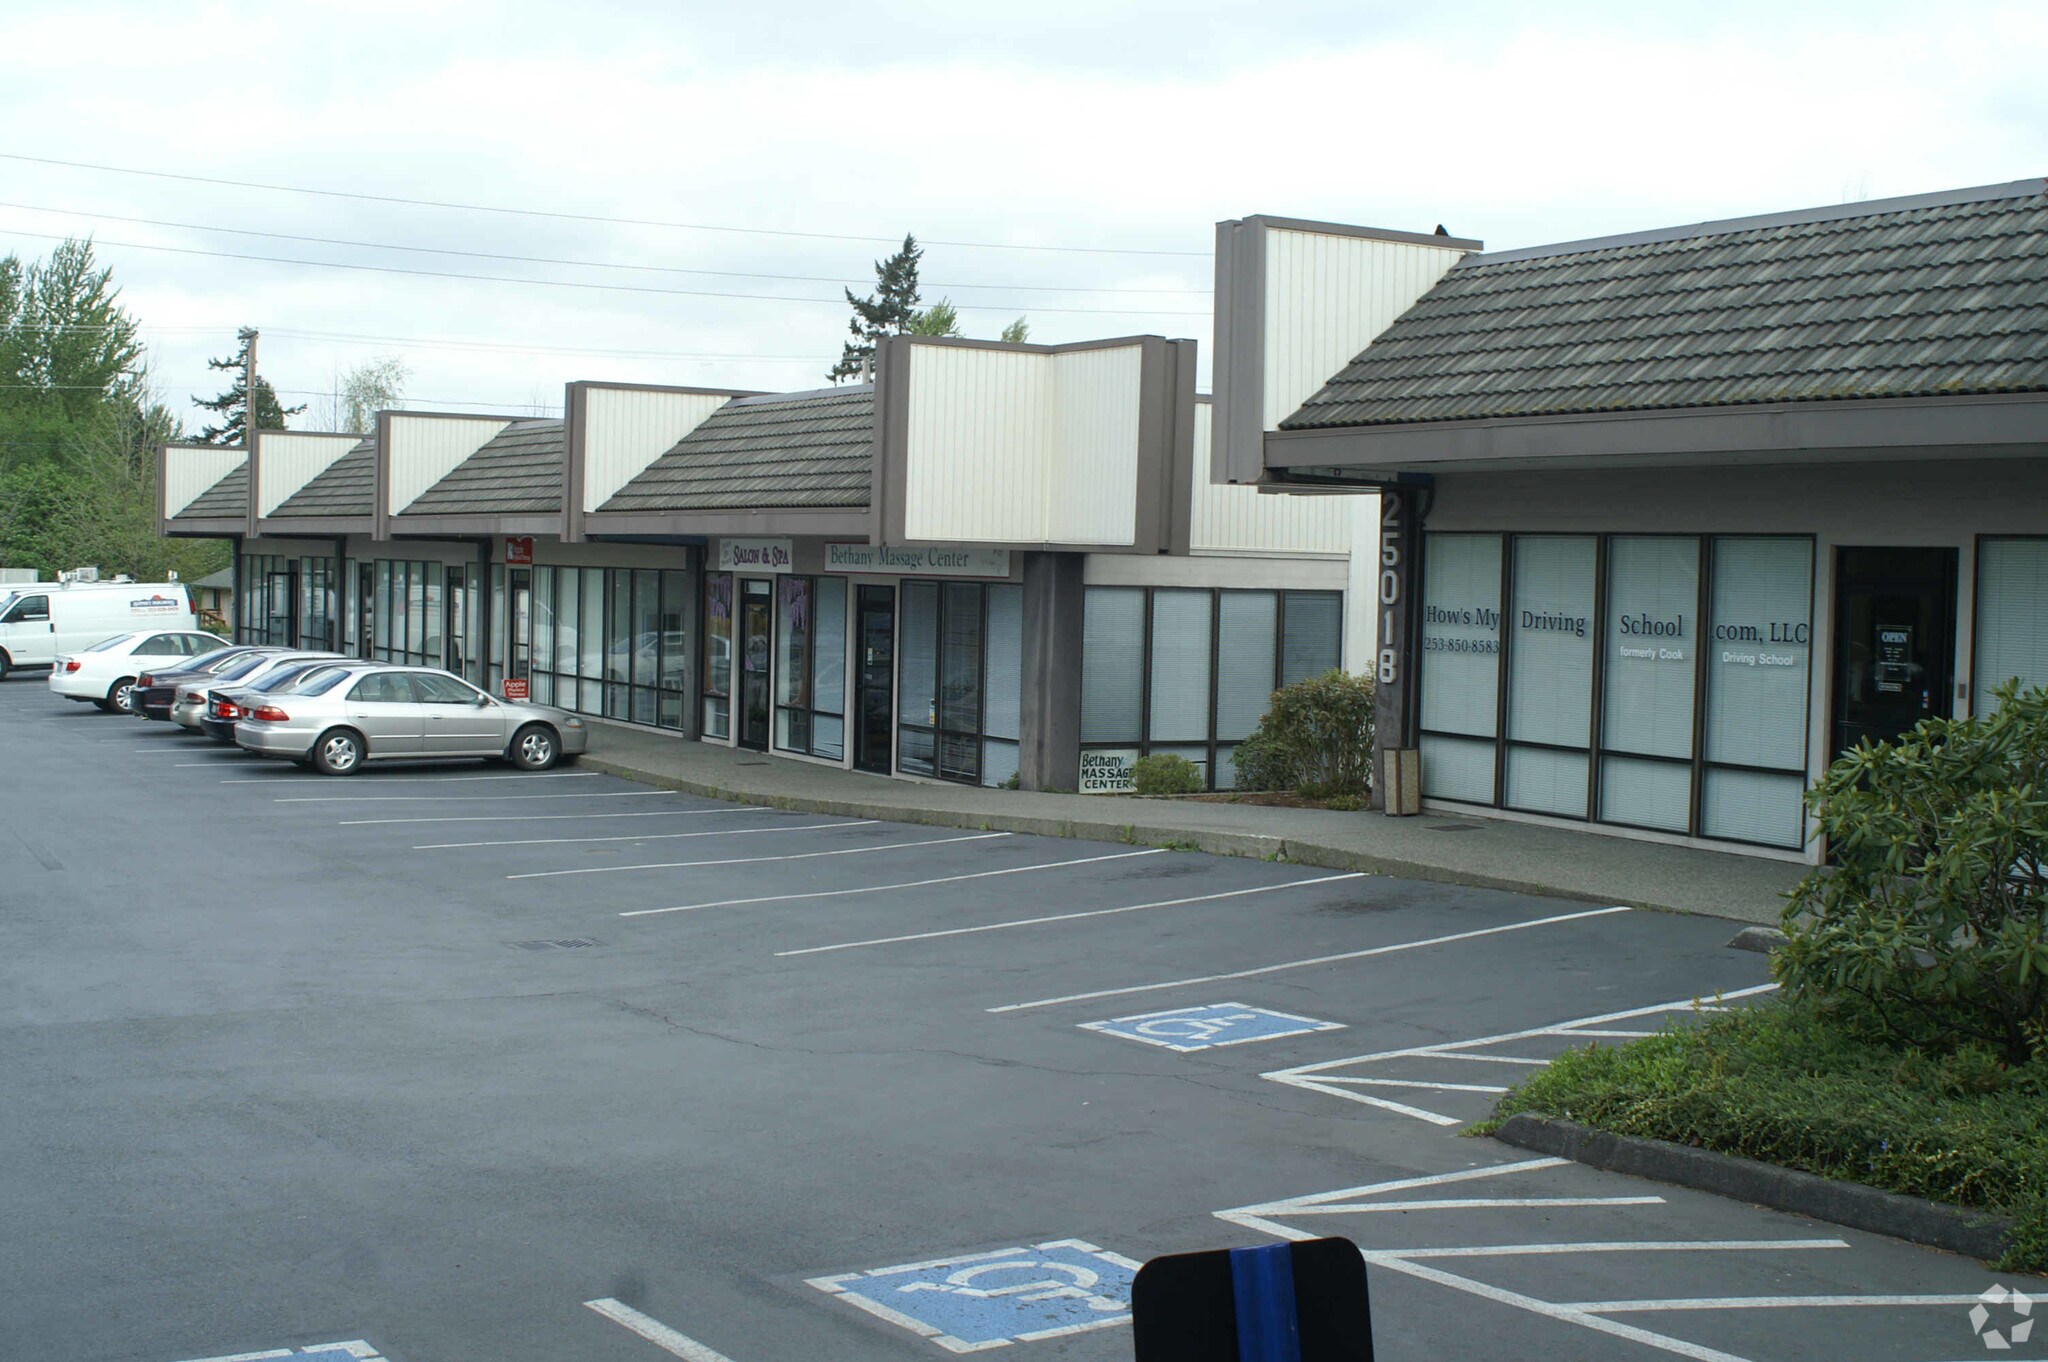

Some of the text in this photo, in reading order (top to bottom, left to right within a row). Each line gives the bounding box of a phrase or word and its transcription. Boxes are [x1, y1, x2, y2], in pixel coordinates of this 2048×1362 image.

[734, 545, 760, 566] SALON
[762, 547, 770, 564] &
[772, 546, 789, 567] SPA
[831, 545, 874, 568] Bethany
[878, 547, 923, 570] Massage
[928, 548, 969, 567] Center
[1379, 492, 1401, 684] 25018
[1426, 605, 1470, 625] How's
[1475, 608, 1500, 631] My
[1522, 611, 1585, 637] Driving
[1620, 614, 1682, 637] School
[1769, 622, 1808, 644] LLC
[1424, 637, 1499, 654] 253-850-8583
[1881, 632, 1908, 643] OPEN
[1620, 646, 1683, 660] formerly Cook
[1723, 652, 1793, 666] Driving School
[1082, 753, 1123, 769] Bethany
[1085, 780, 1129, 789] CENTER
